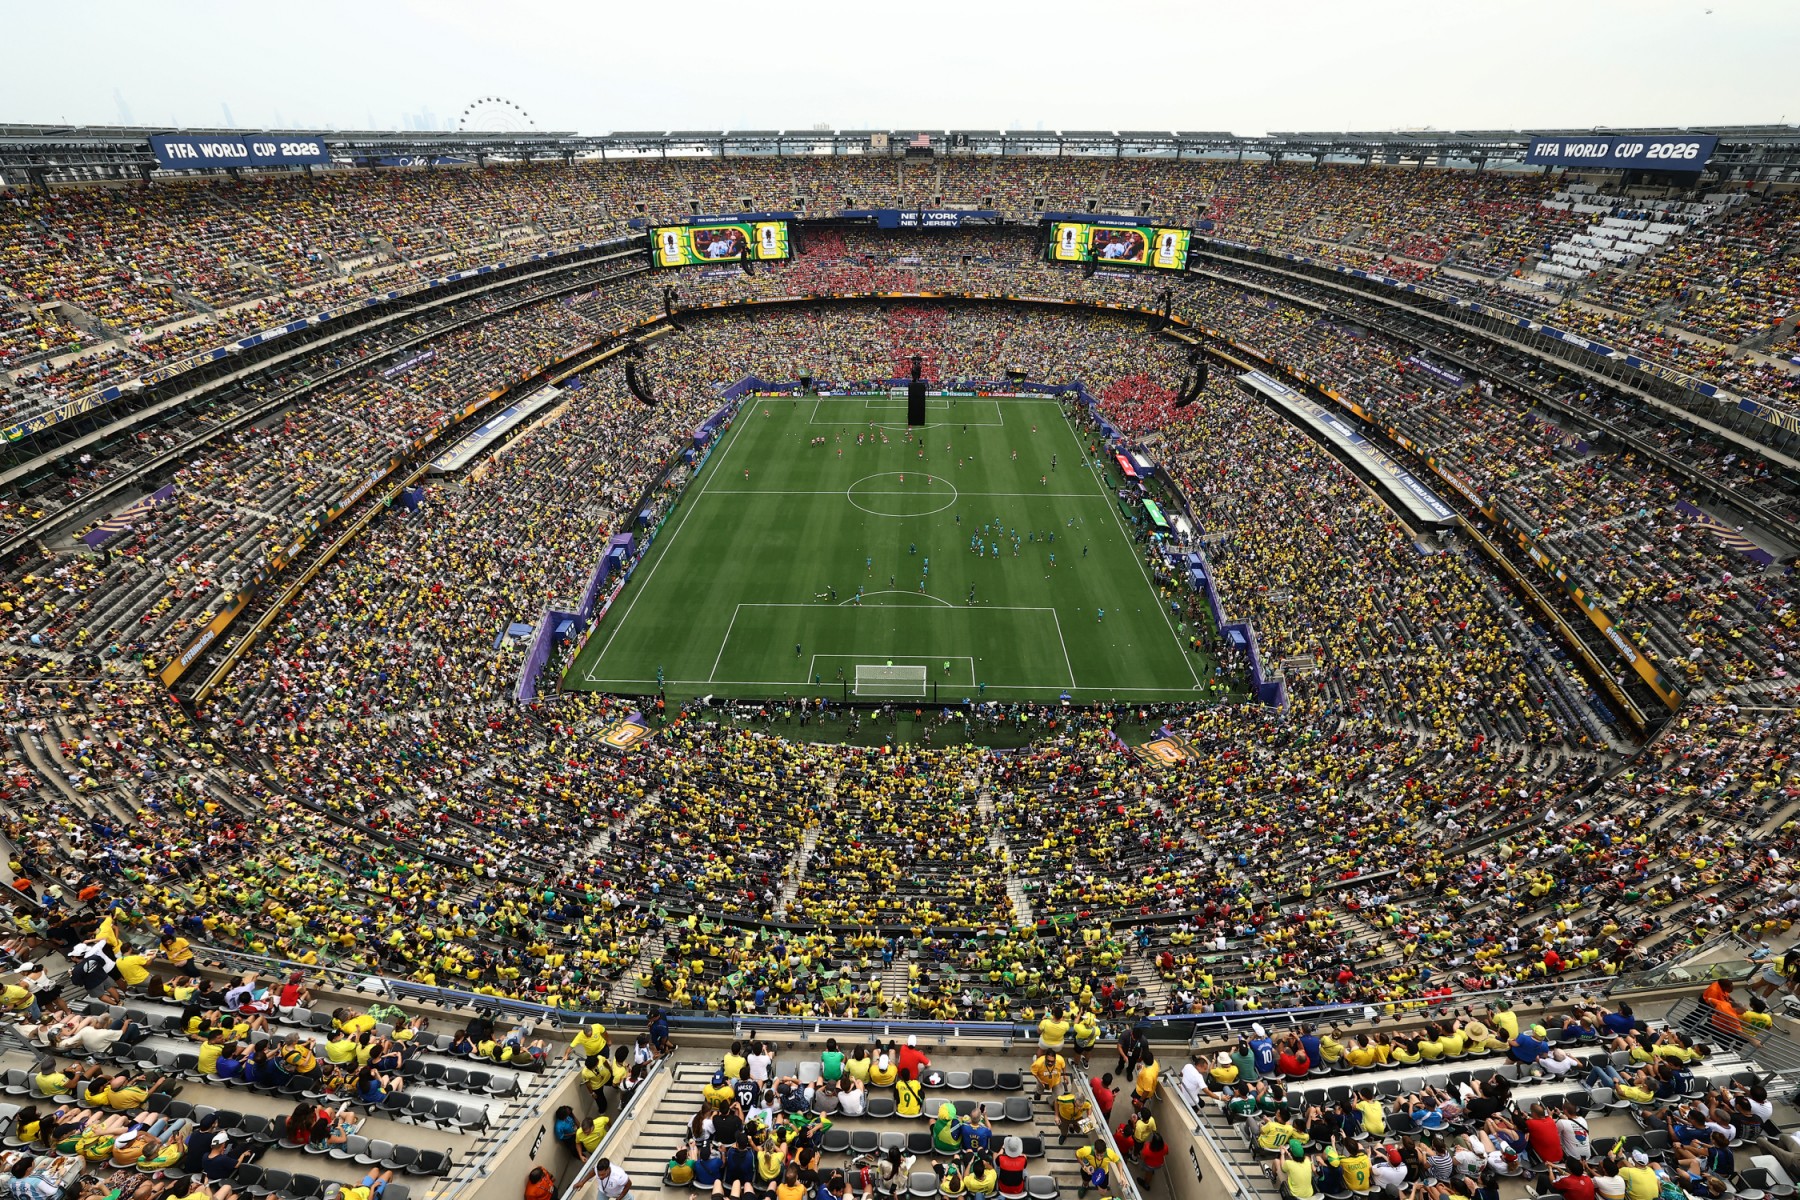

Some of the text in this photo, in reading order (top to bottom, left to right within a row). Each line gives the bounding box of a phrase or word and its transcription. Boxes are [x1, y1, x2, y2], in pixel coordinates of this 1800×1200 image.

[164, 142, 320, 159] FIFA WORLD CUP 2026
[1534, 142, 1700, 159] FIFA WORLD CUP 2026
[1438, 464, 1483, 507] FIFA WORLD CUP 2026
[1402, 476, 1414, 485] FIFA
[1411, 483, 1427, 496] WORLD
[1431, 502, 1450, 516] 2026
[181, 630, 215, 666] #FIFAWorldCup
[1262, 1050, 1272, 1064] 10
[1685, 1078, 1694, 1092] 10
[738, 1091, 753, 1106] 19
[904, 1092, 910, 1107] 9
[970, 1140, 979, 1148] 8
[1273, 1133, 1286, 1146] 10
[1356, 1171, 1364, 1185] 9
